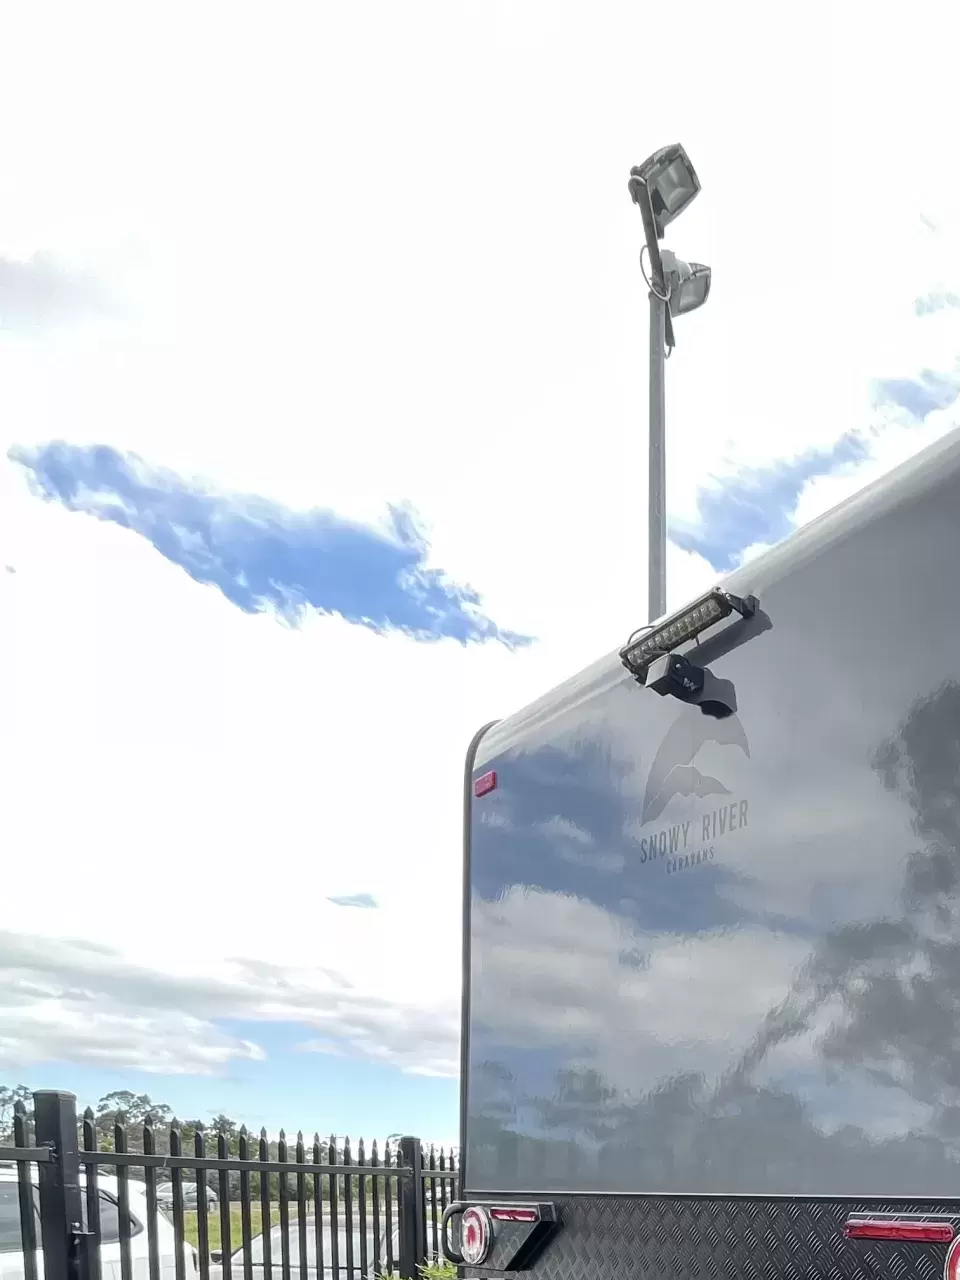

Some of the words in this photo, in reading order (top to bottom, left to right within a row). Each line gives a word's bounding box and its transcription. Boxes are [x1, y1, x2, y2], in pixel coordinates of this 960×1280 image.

[640, 821, 692, 864] SNOWY
[702, 799, 749, 842] RIVER
[666, 846, 716, 875] CARAVANS
